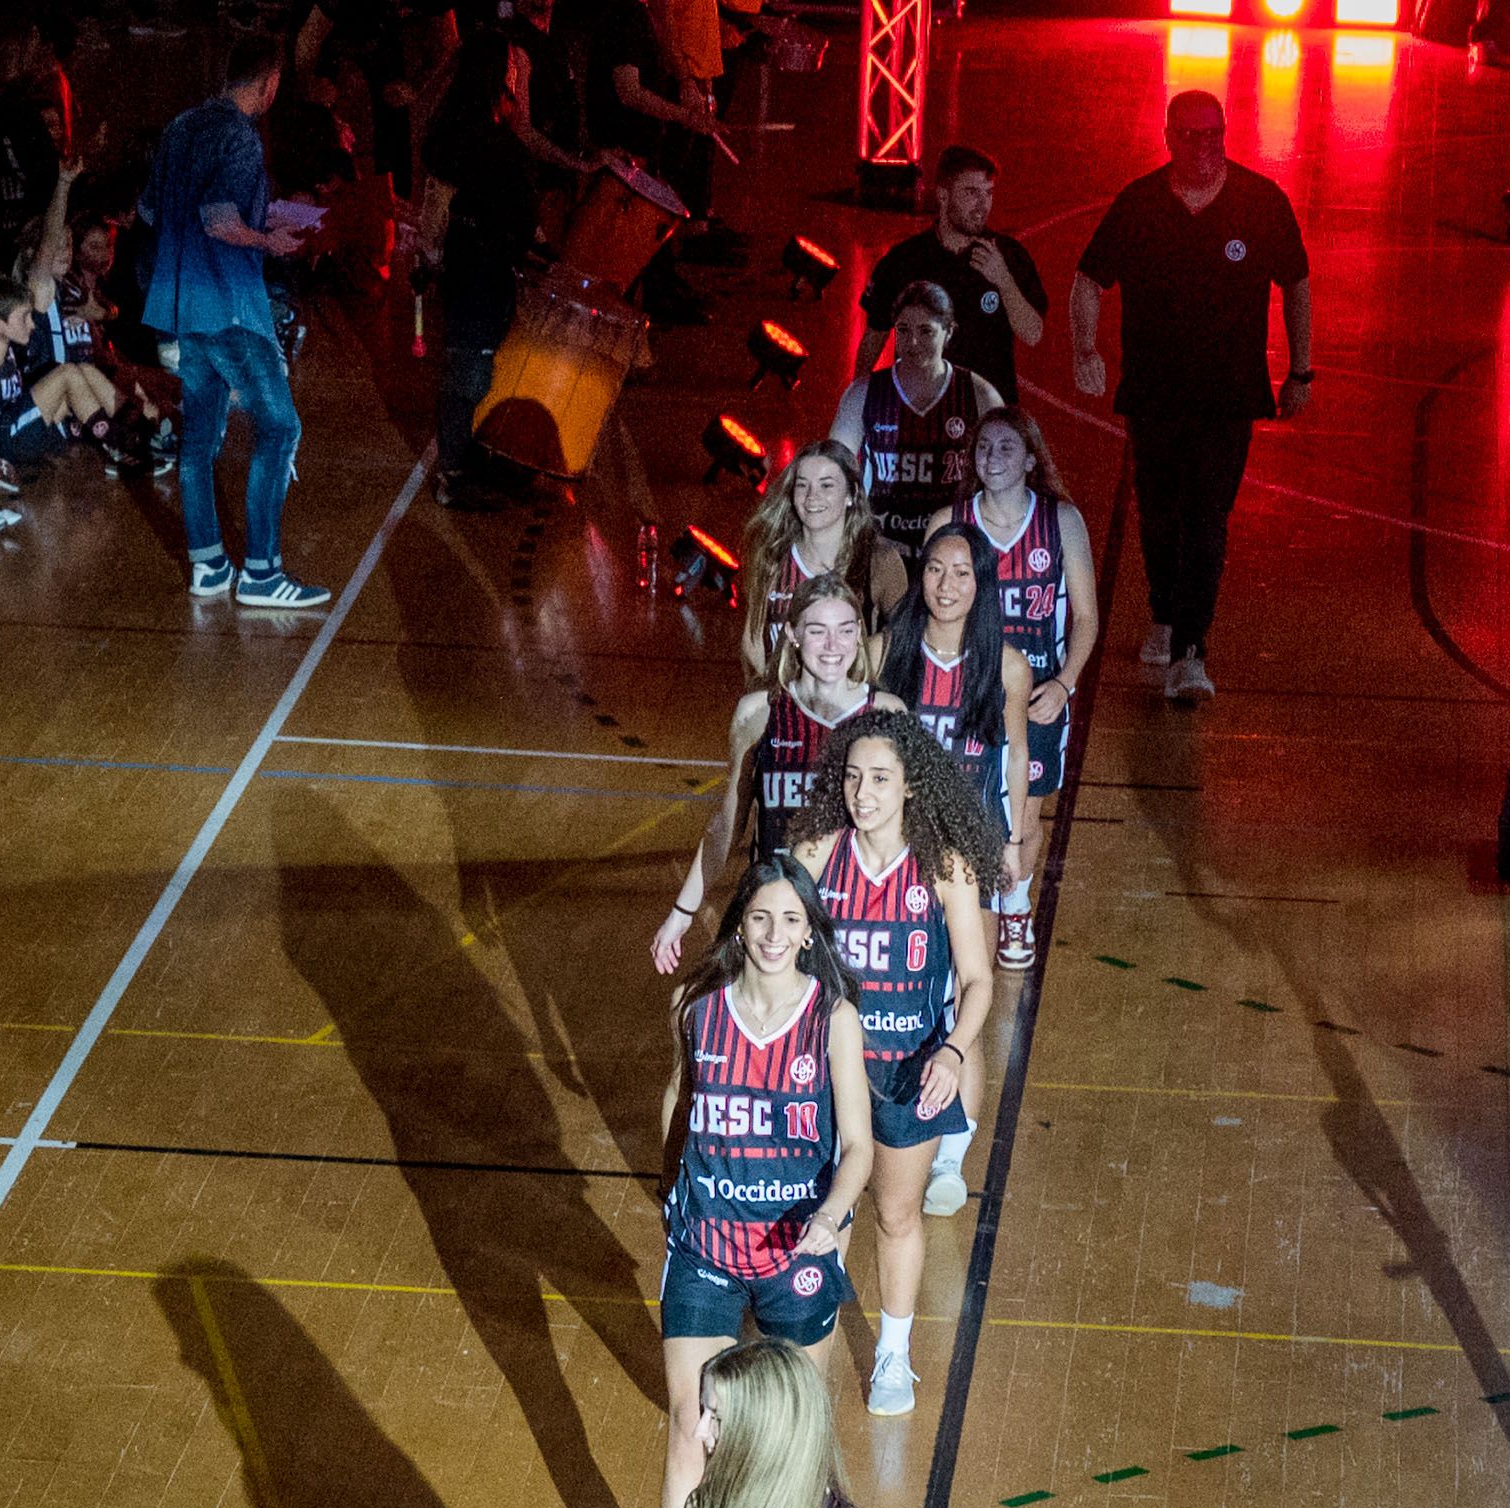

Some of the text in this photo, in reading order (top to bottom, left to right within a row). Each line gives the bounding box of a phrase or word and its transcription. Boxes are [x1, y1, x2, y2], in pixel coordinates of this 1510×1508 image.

[873, 452, 934, 483] UESC
[1026, 583, 1056, 620] 24
[906, 930, 928, 972] 6
[859, 1010, 924, 1032] cident
[690, 1094, 772, 1136] UESC
[718, 1178, 818, 1202] Occident
